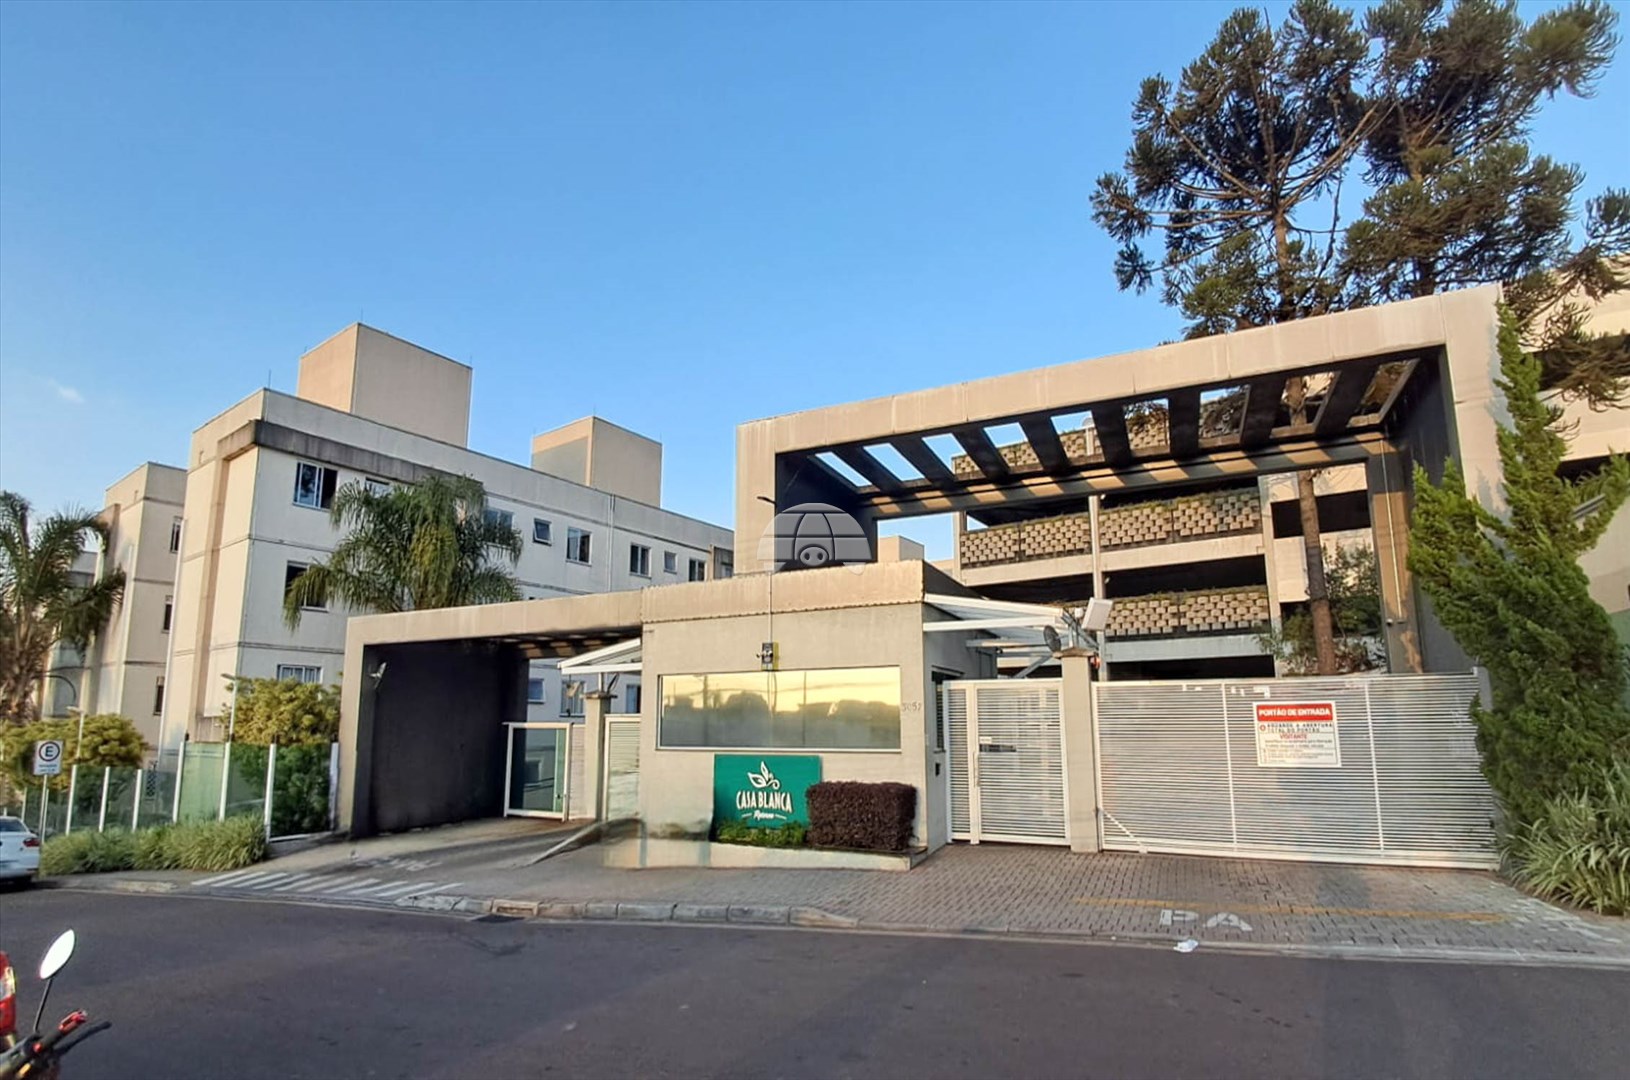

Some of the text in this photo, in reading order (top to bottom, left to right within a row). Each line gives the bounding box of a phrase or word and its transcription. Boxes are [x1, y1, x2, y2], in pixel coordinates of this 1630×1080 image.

[1258, 707, 1331, 716] PORTÃO DE ENTRADA
[45, 746, 54, 757] E
[736, 790, 793, 813] CASA BLANCA
